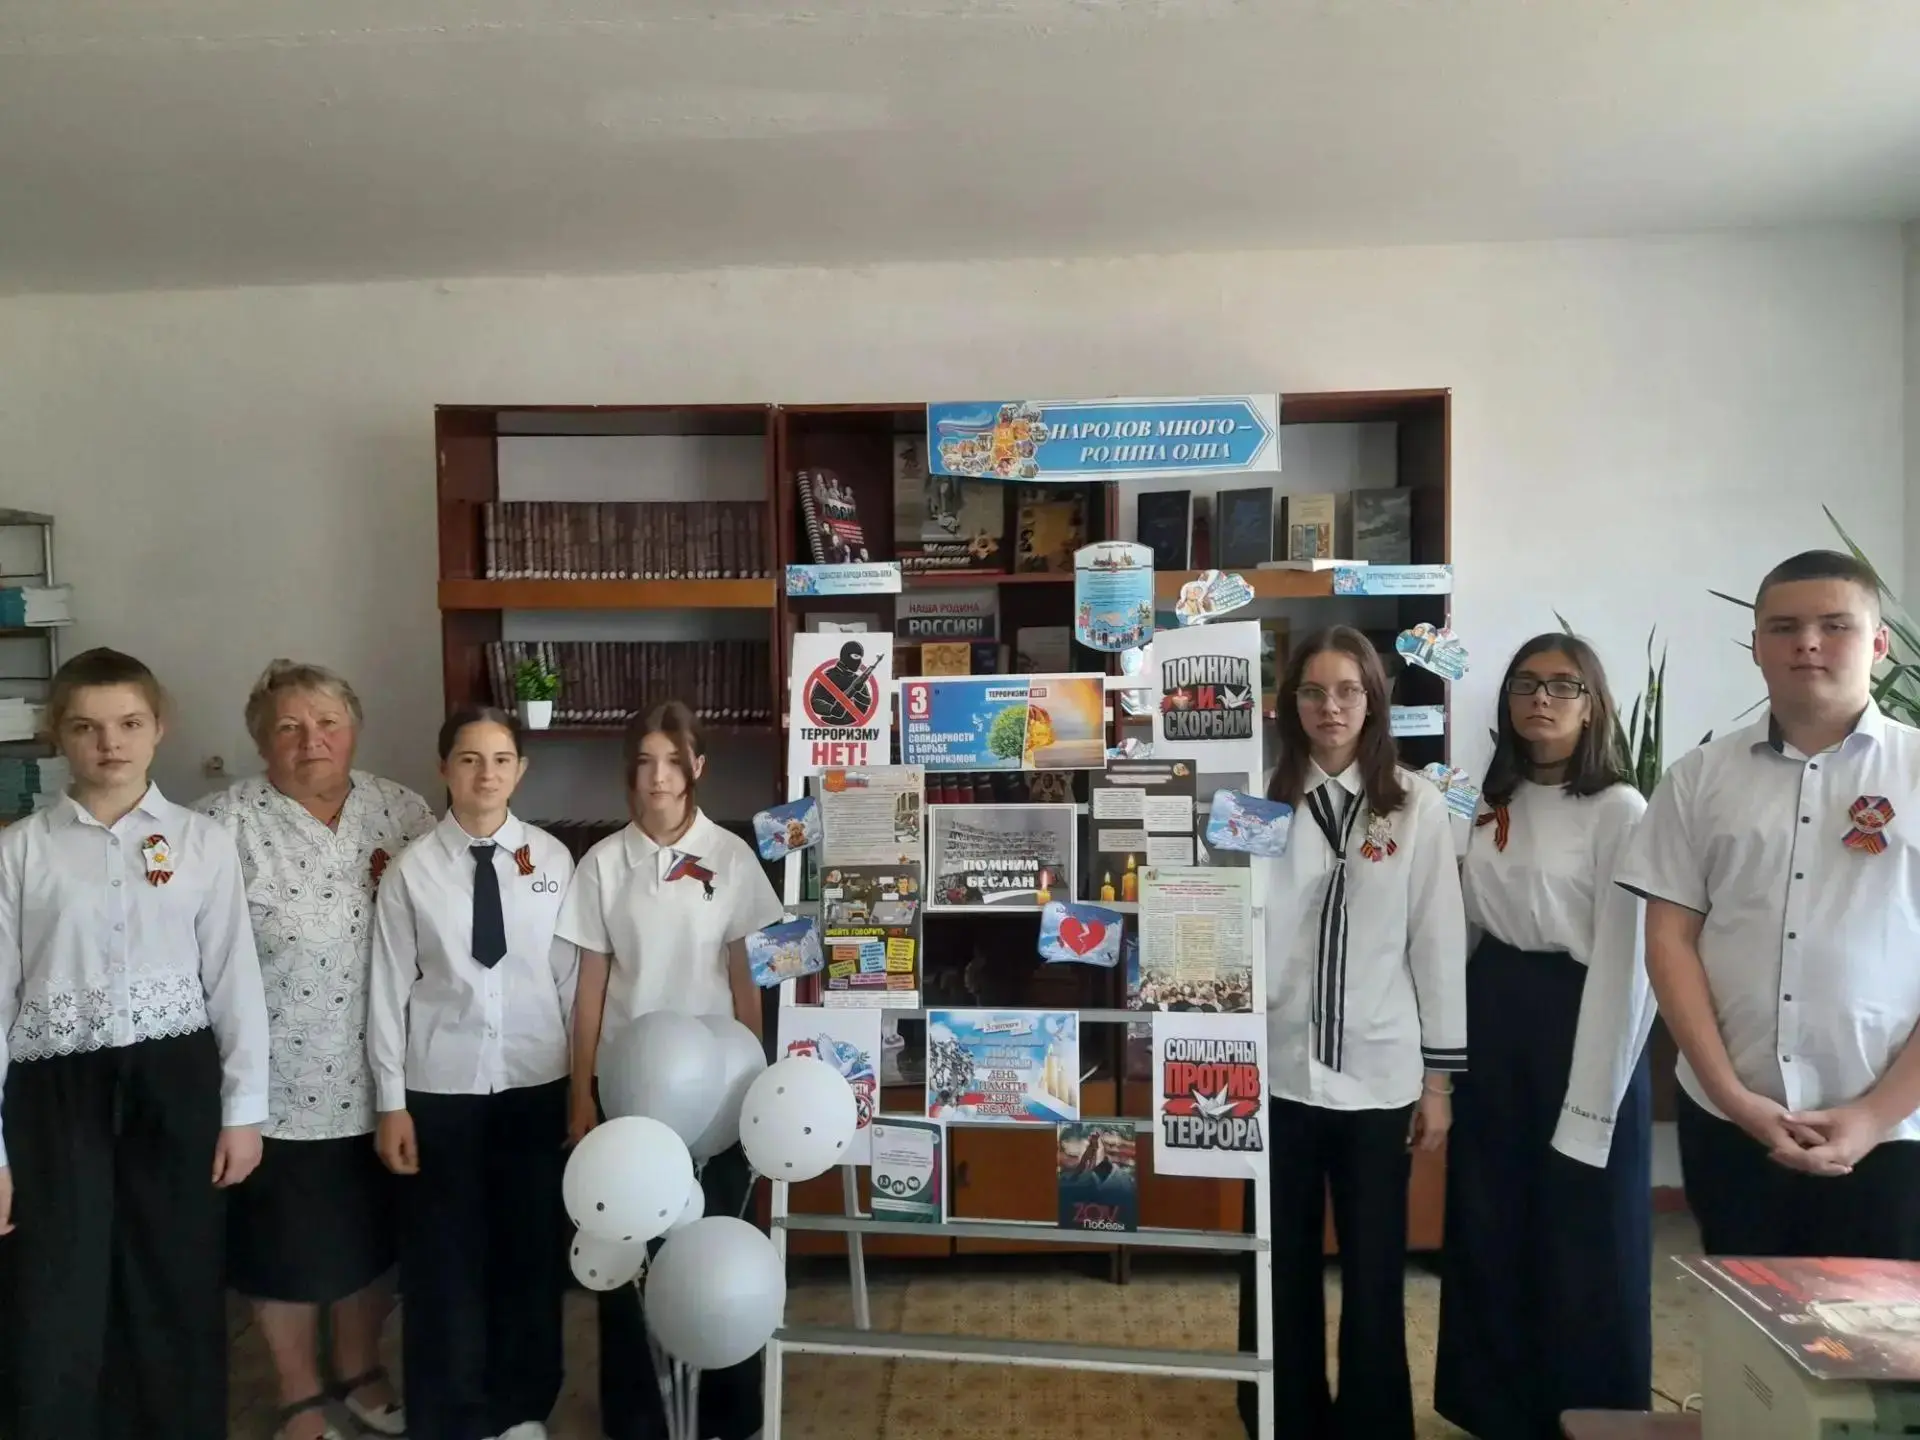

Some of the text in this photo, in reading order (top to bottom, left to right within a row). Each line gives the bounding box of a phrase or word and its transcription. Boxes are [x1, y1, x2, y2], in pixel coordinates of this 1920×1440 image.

[1050, 421, 1151, 440] НАРОДОВ
[1156, 418, 1235, 437] МНОГО
[1080, 442, 1230, 463] РОДИНА ОДНА
[909, 602, 980, 614] НАША РОДИНА
[908, 618, 983, 636] РОССИЯ!
[1164, 655, 1249, 690] ПОМНИМ
[911, 686, 928, 714] 3
[1197, 685, 1216, 710] И
[908, 723, 931, 733] ДЕНЬ
[1165, 709, 1251, 738] СКОРБИМ
[800, 728, 880, 741] ТЕРРОРИЗМУ
[908, 732, 975, 744] СОЛИДАРНОСТИ
[812, 742, 867, 766] НЕТ!
[908, 743, 948, 754] В БОРЬБЕ
[909, 753, 977, 764] С ТЕРРОРИЗМОМ
[963, 859, 1039, 871] ПОМНИМ
[966, 875, 1035, 888] БЕСЛАН
[1165, 1038, 1257, 1064] СОЛИДАРНЫ
[987, 1070, 1018, 1081] ДЕНЬ
[1164, 1061, 1260, 1098] ПРОТИВ
[978, 1081, 1028, 1093] ПАМЯТИ
[1163, 1115, 1263, 1149] ТЕРРОРА
[1083, 1218, 1125, 1231] Победы
